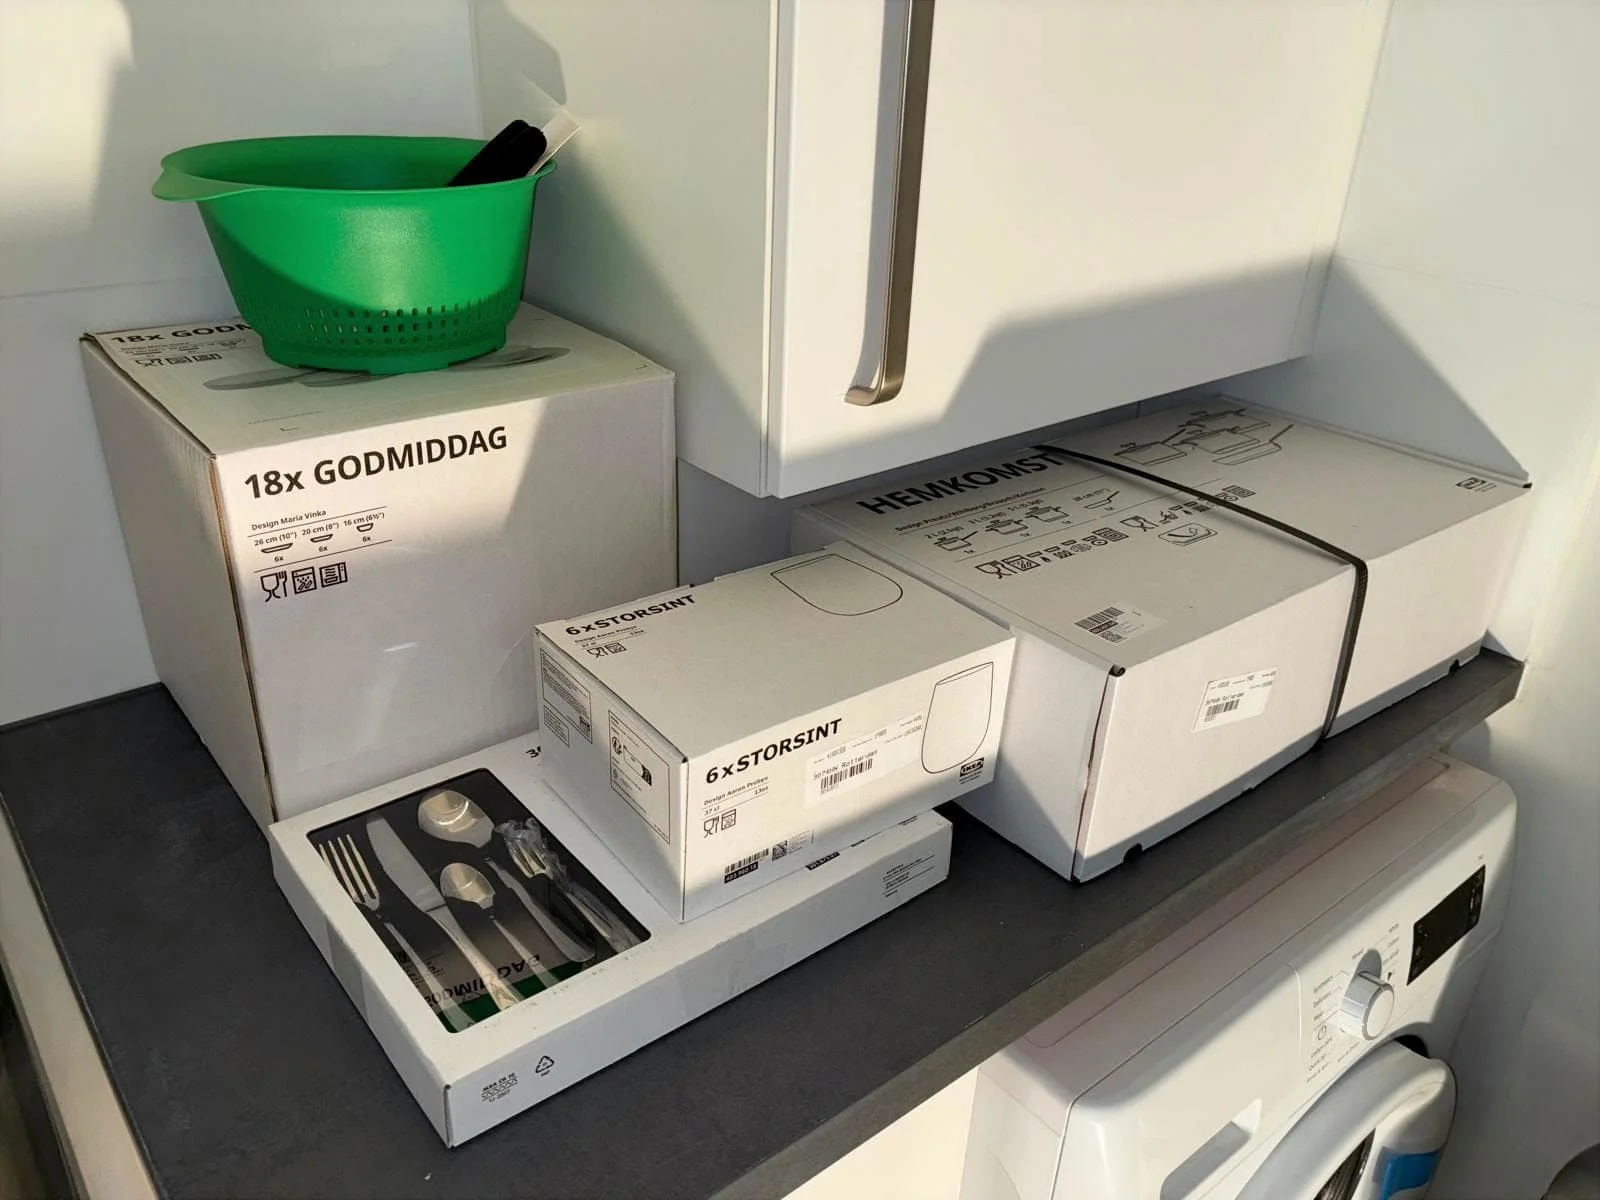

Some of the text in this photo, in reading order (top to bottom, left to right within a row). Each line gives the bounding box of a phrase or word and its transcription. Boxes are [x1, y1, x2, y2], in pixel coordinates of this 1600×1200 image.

[111, 323, 253, 343] 18x GODM
[244, 426, 507, 499] 18x GODMIDDAG
[856, 453, 1064, 515] HEMKOMST
[251, 510, 327, 531] Design Maria Vinka
[343, 519, 352, 527] 16
[353, 517, 365, 525] cm
[254, 531, 297, 547] 26 cm (10")
[301, 528, 311, 536] 20
[312, 526, 324, 534] cm
[362, 535, 371, 543] 6x
[704, 793, 726, 806] Design
[727, 785, 746, 796] Aaron
